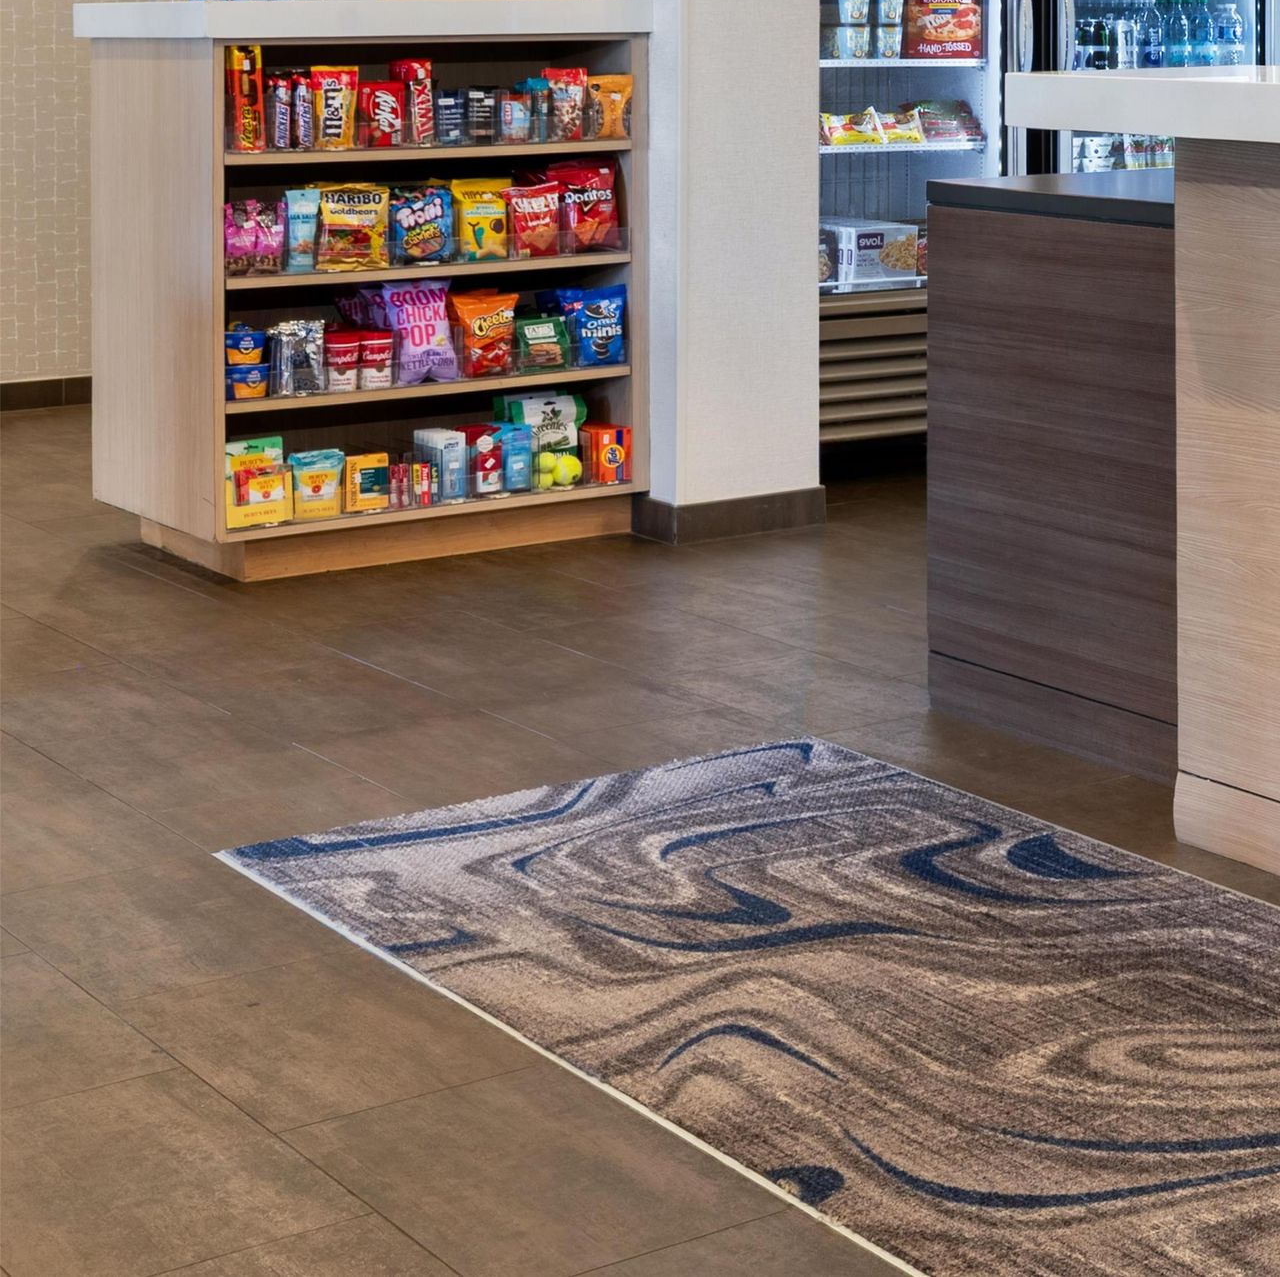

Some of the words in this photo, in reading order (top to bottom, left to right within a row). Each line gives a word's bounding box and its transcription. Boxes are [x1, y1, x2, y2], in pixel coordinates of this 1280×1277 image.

[325, 192, 382, 205] HARIBO
[564, 189, 613, 204] Doritos
[390, 287, 448, 309] BOOM
[473, 311, 514, 337] Cheeto
[581, 323, 623, 338] minis
[398, 324, 436, 347] POP
